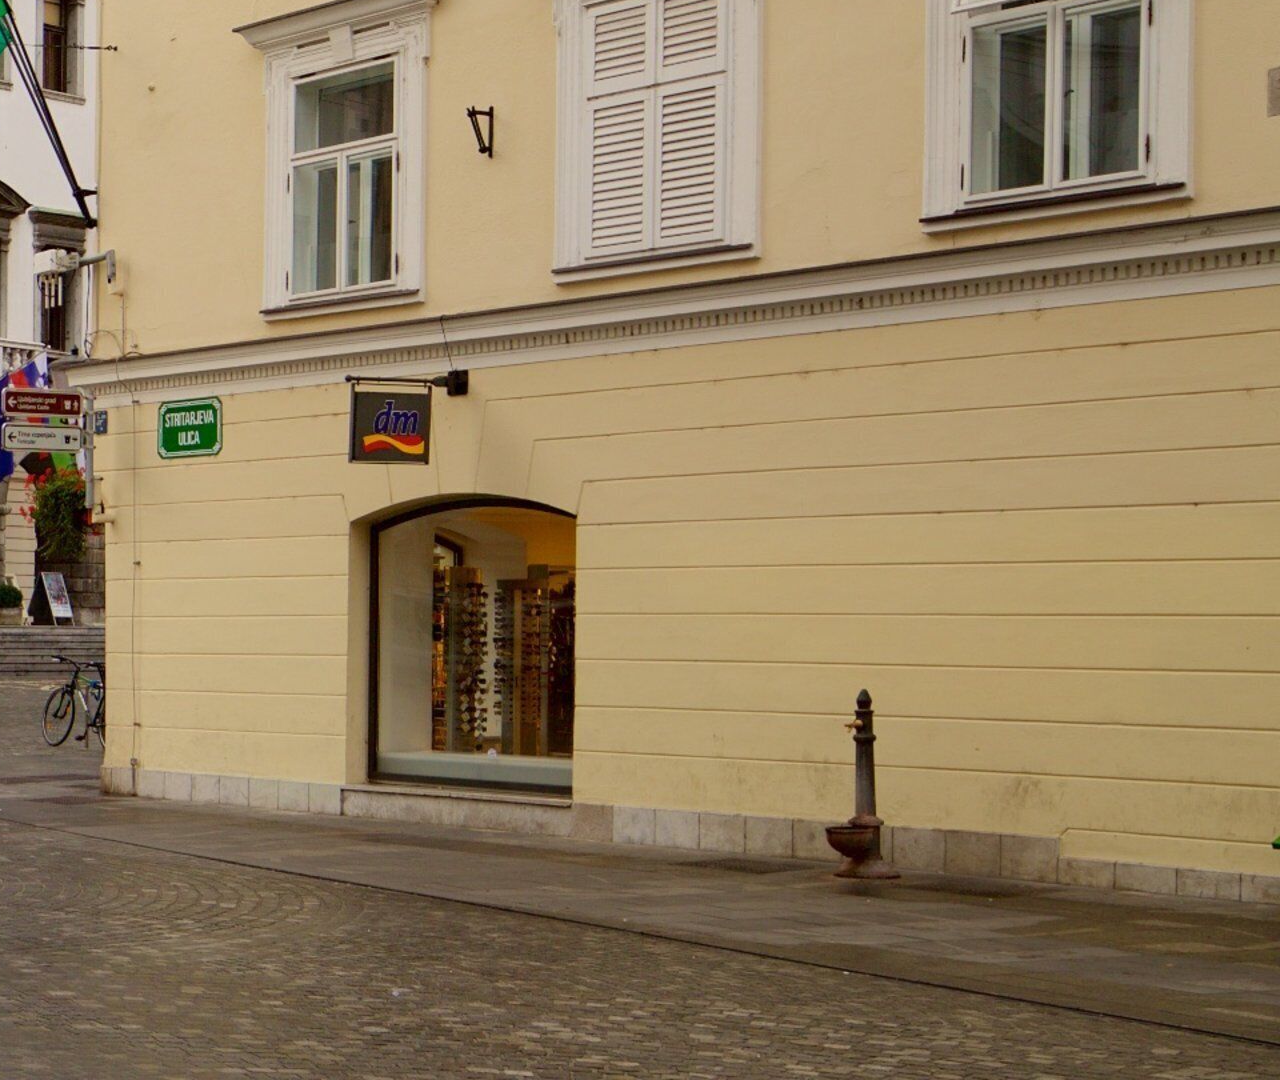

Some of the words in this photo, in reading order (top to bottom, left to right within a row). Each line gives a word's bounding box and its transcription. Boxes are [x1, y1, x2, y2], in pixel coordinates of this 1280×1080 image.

[164, 408, 215, 429] STRITARJEVA
[373, 399, 420, 436] dm
[177, 430, 201, 447] ULICA
